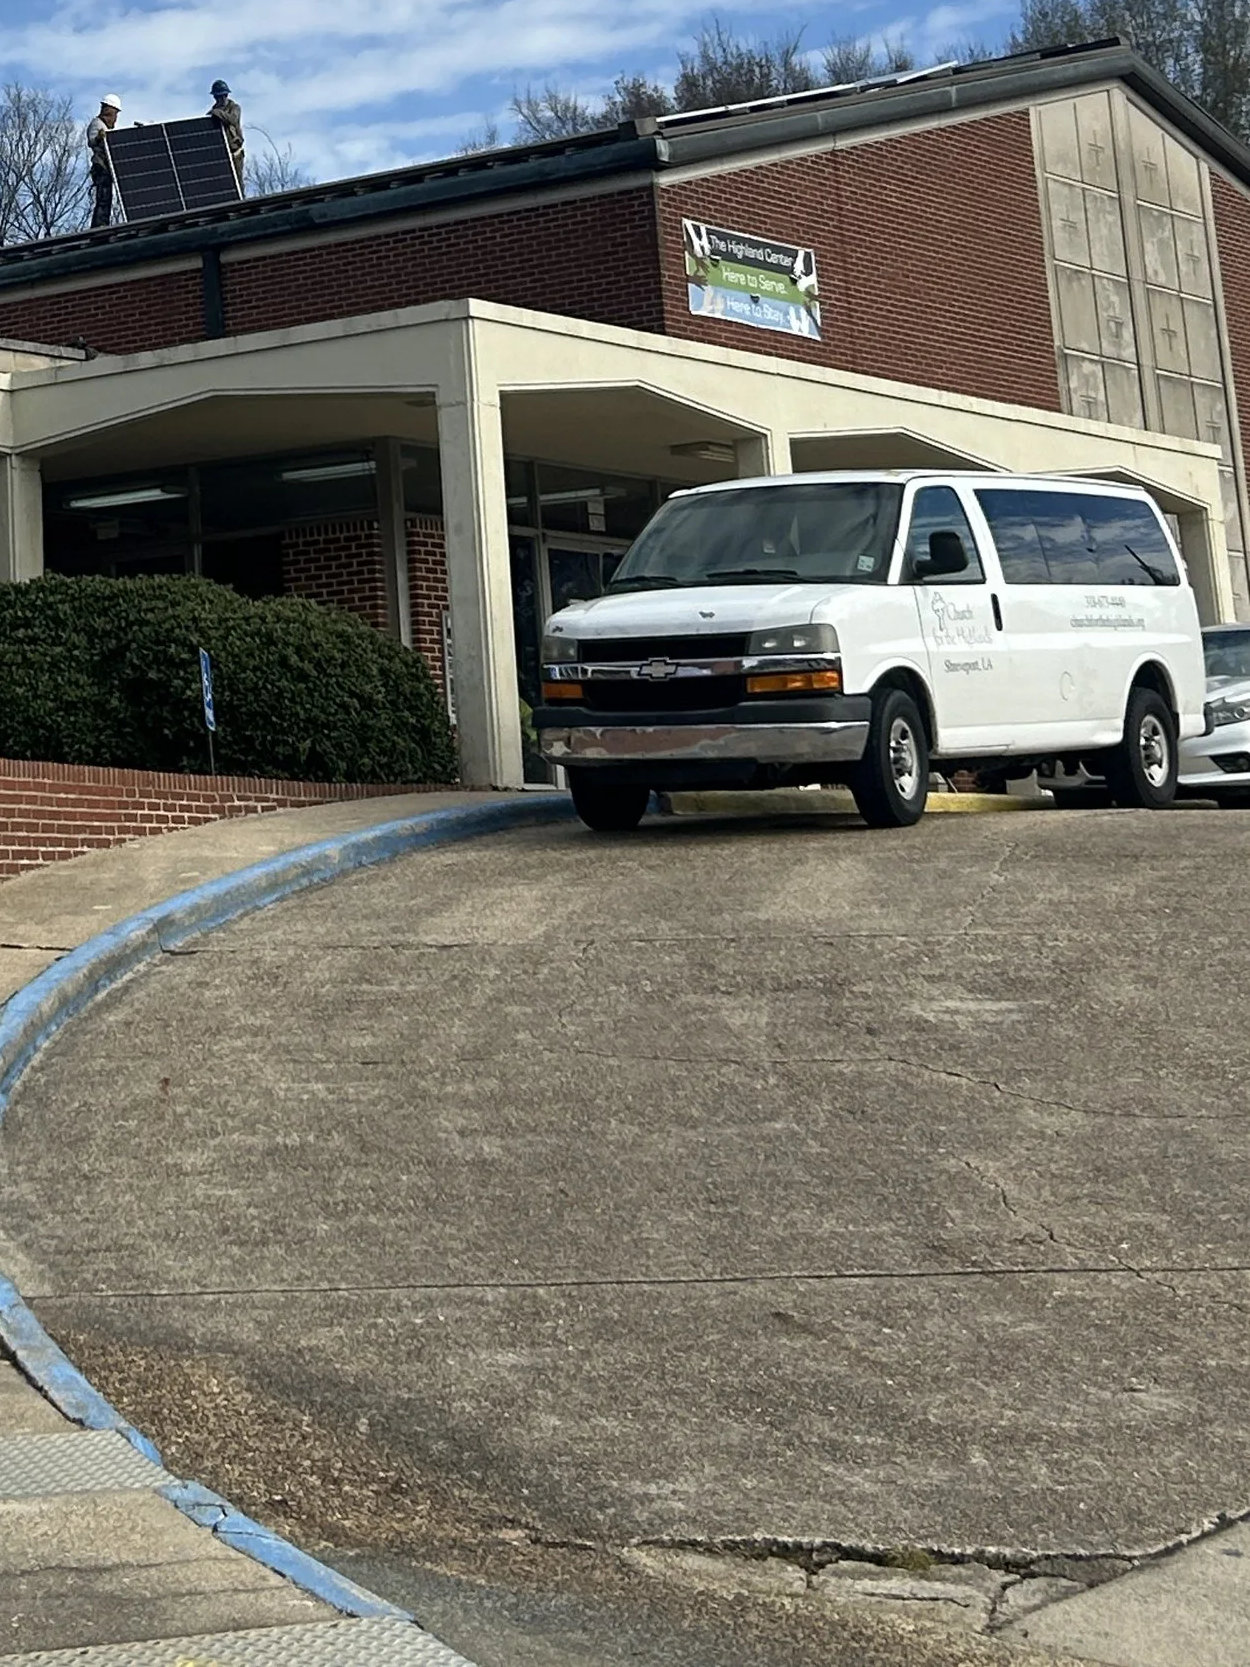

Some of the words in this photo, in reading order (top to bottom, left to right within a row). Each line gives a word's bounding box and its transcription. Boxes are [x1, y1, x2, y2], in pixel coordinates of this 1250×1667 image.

[709, 235, 727, 252] The
[727, 239, 764, 261] Highland
[765, 248, 794, 266] Center
[722, 267, 746, 285] Here
[747, 273, 758, 287] to
[726, 296, 751, 316] Here
[751, 302, 762, 319] to
